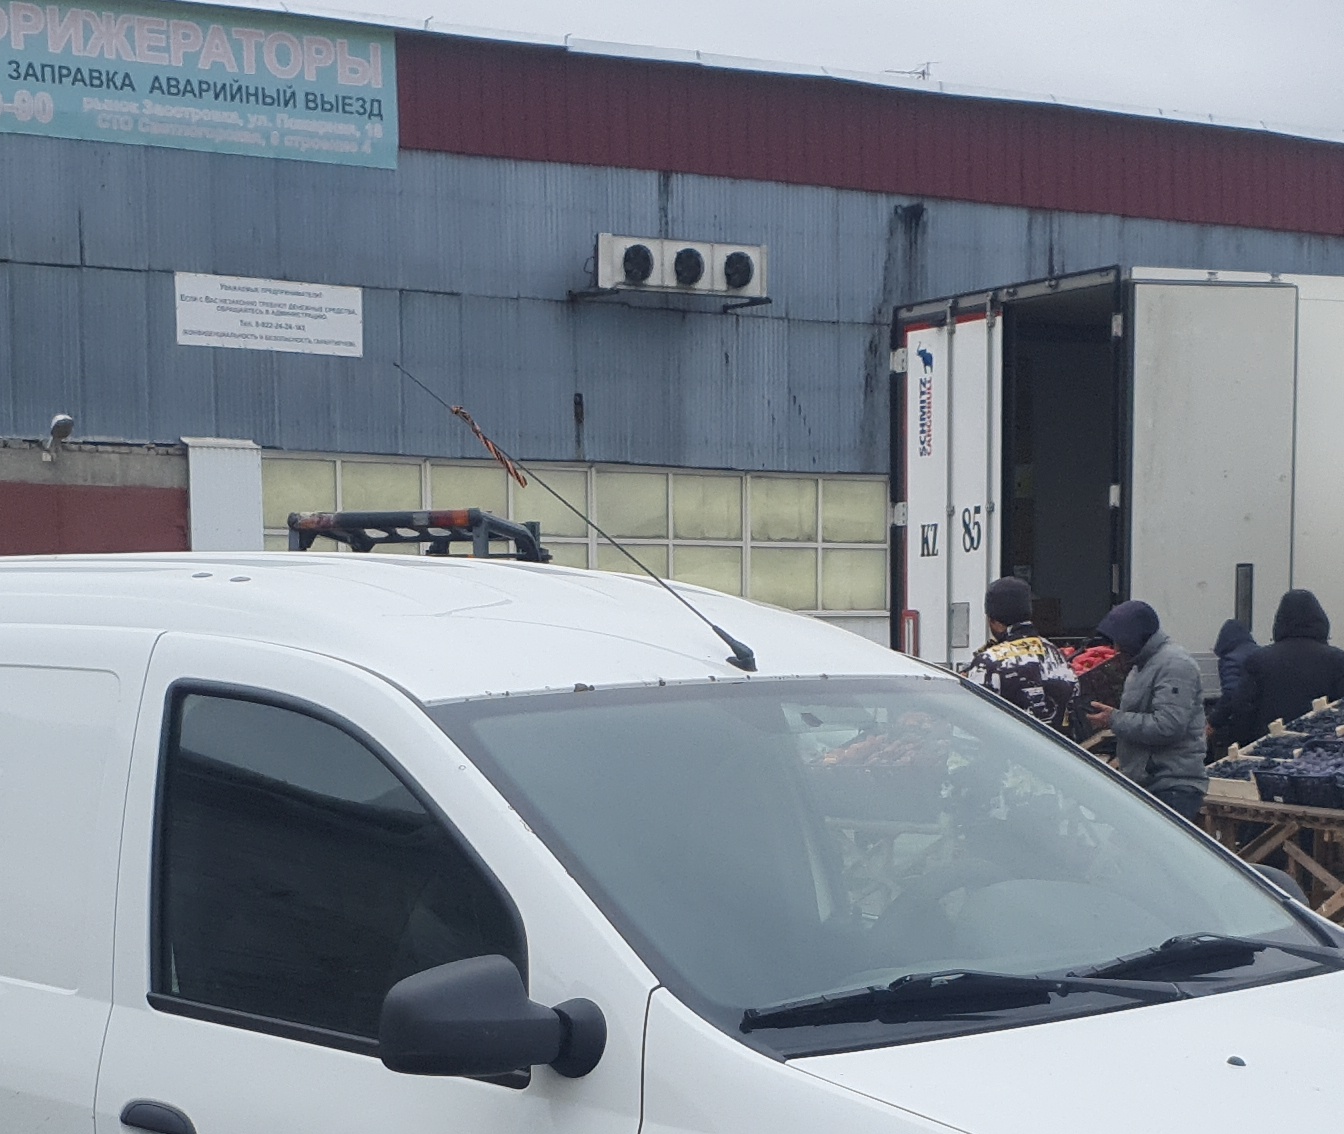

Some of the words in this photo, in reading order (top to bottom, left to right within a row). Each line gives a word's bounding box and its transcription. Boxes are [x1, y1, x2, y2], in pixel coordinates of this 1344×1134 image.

[7, 60, 136, 92] ЗАПРАВКА
[149, 75, 297, 108] АВАРИЙНЫЙ
[305, 92, 383, 120] ВЫЕЗД
[920, 523, 939, 557] KZ
[962, 505, 981, 552] 85
